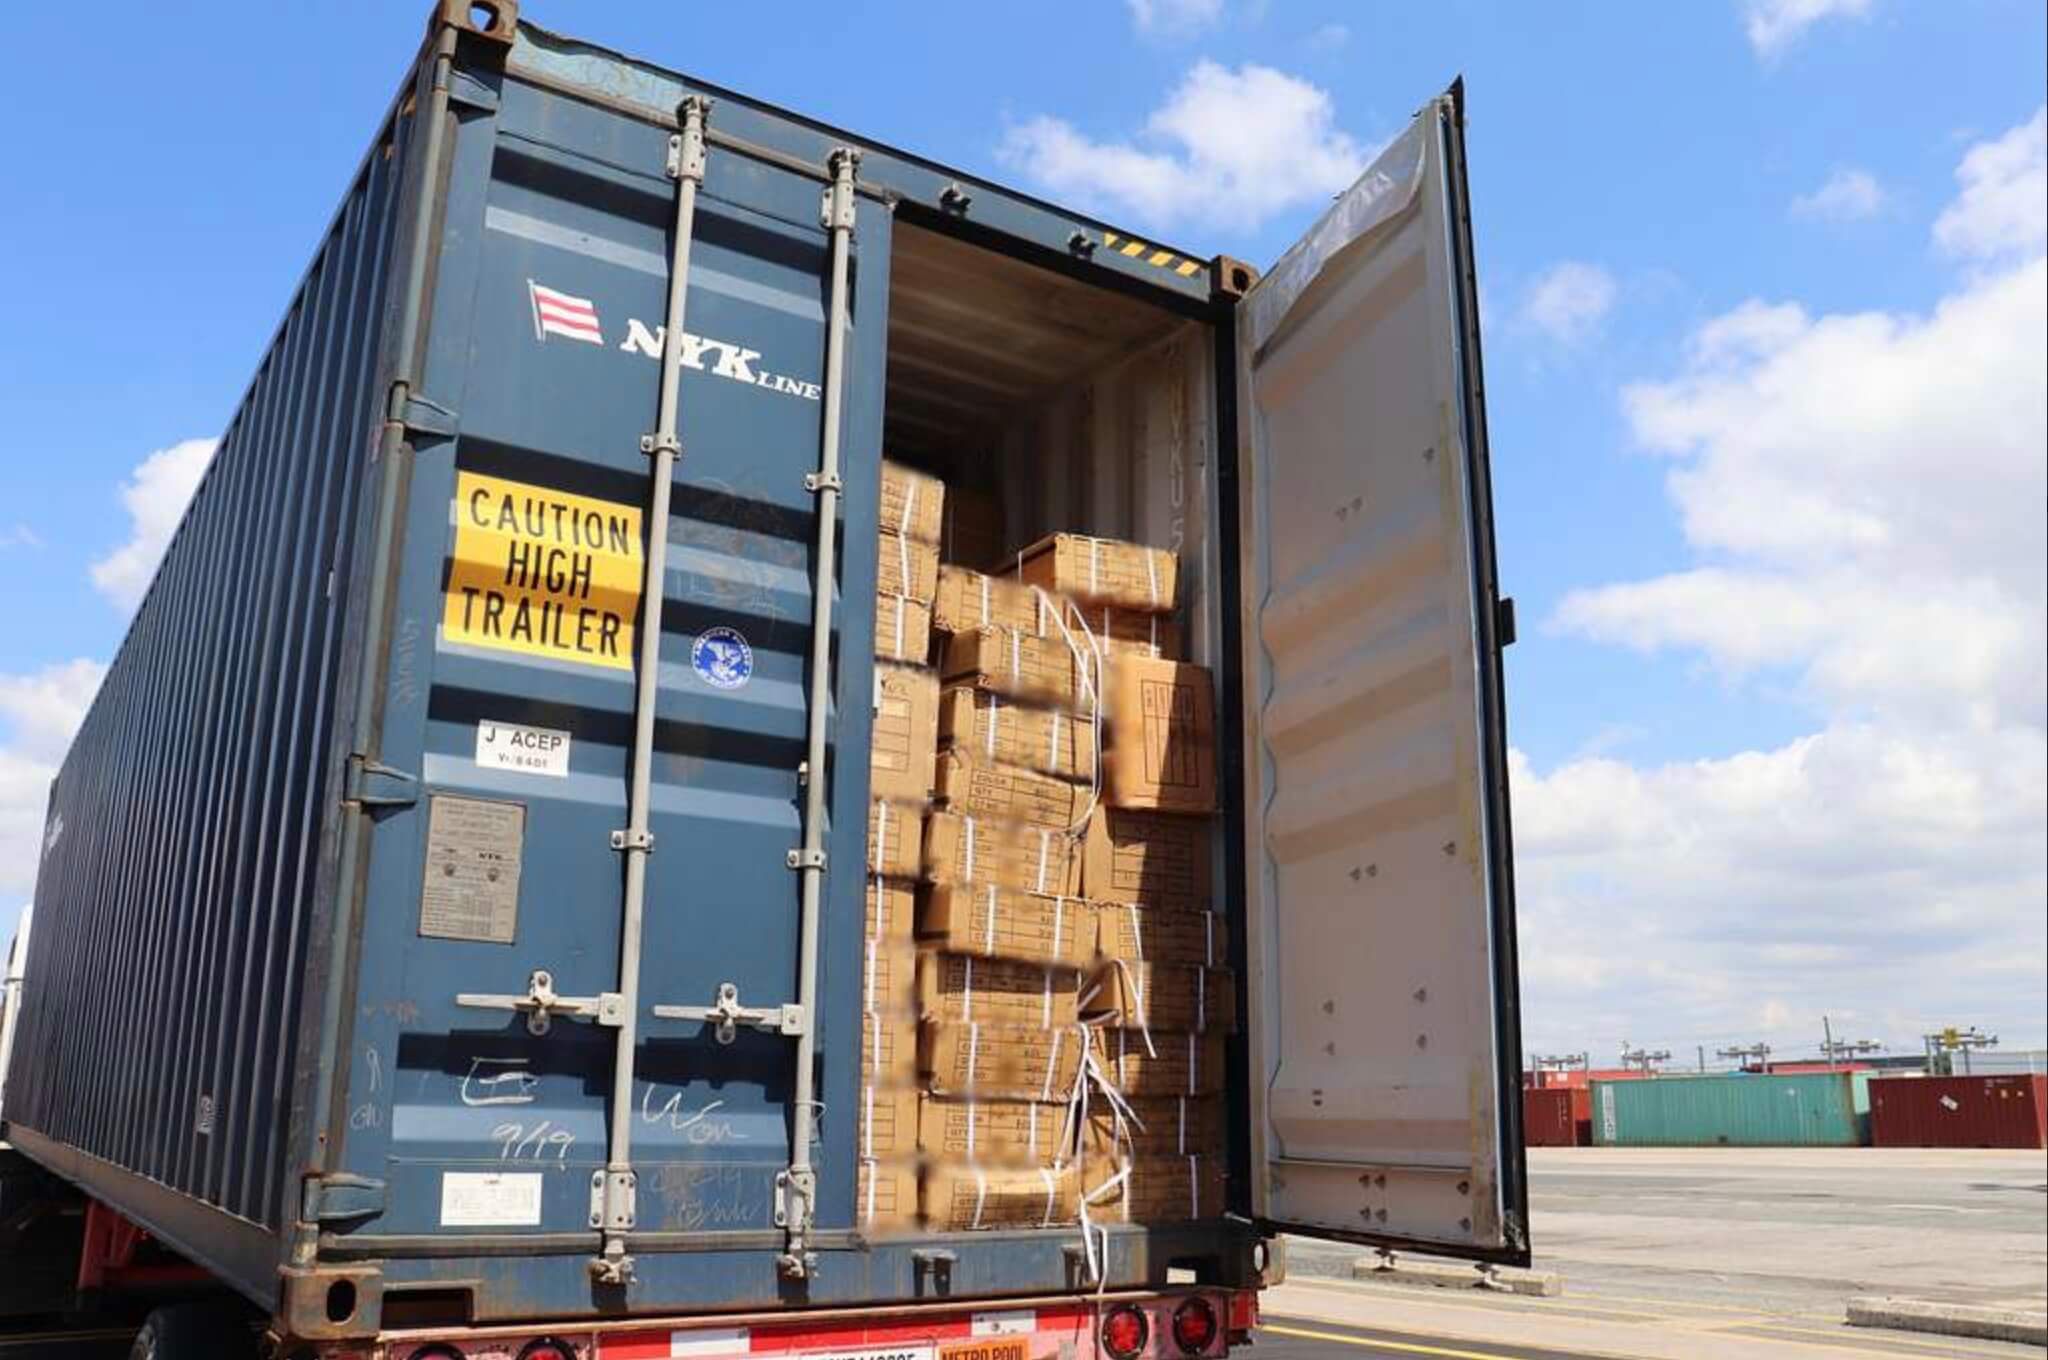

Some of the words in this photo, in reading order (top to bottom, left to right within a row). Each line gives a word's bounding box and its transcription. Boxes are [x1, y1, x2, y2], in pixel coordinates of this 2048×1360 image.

[619, 318, 761, 384] NYK
[754, 371, 822, 400] LINE
[470, 488, 629, 555] CAUTION
[504, 540, 592, 599] HIGH
[462, 586, 621, 657] TRAILER
[510, 730, 562, 752] ACEP
